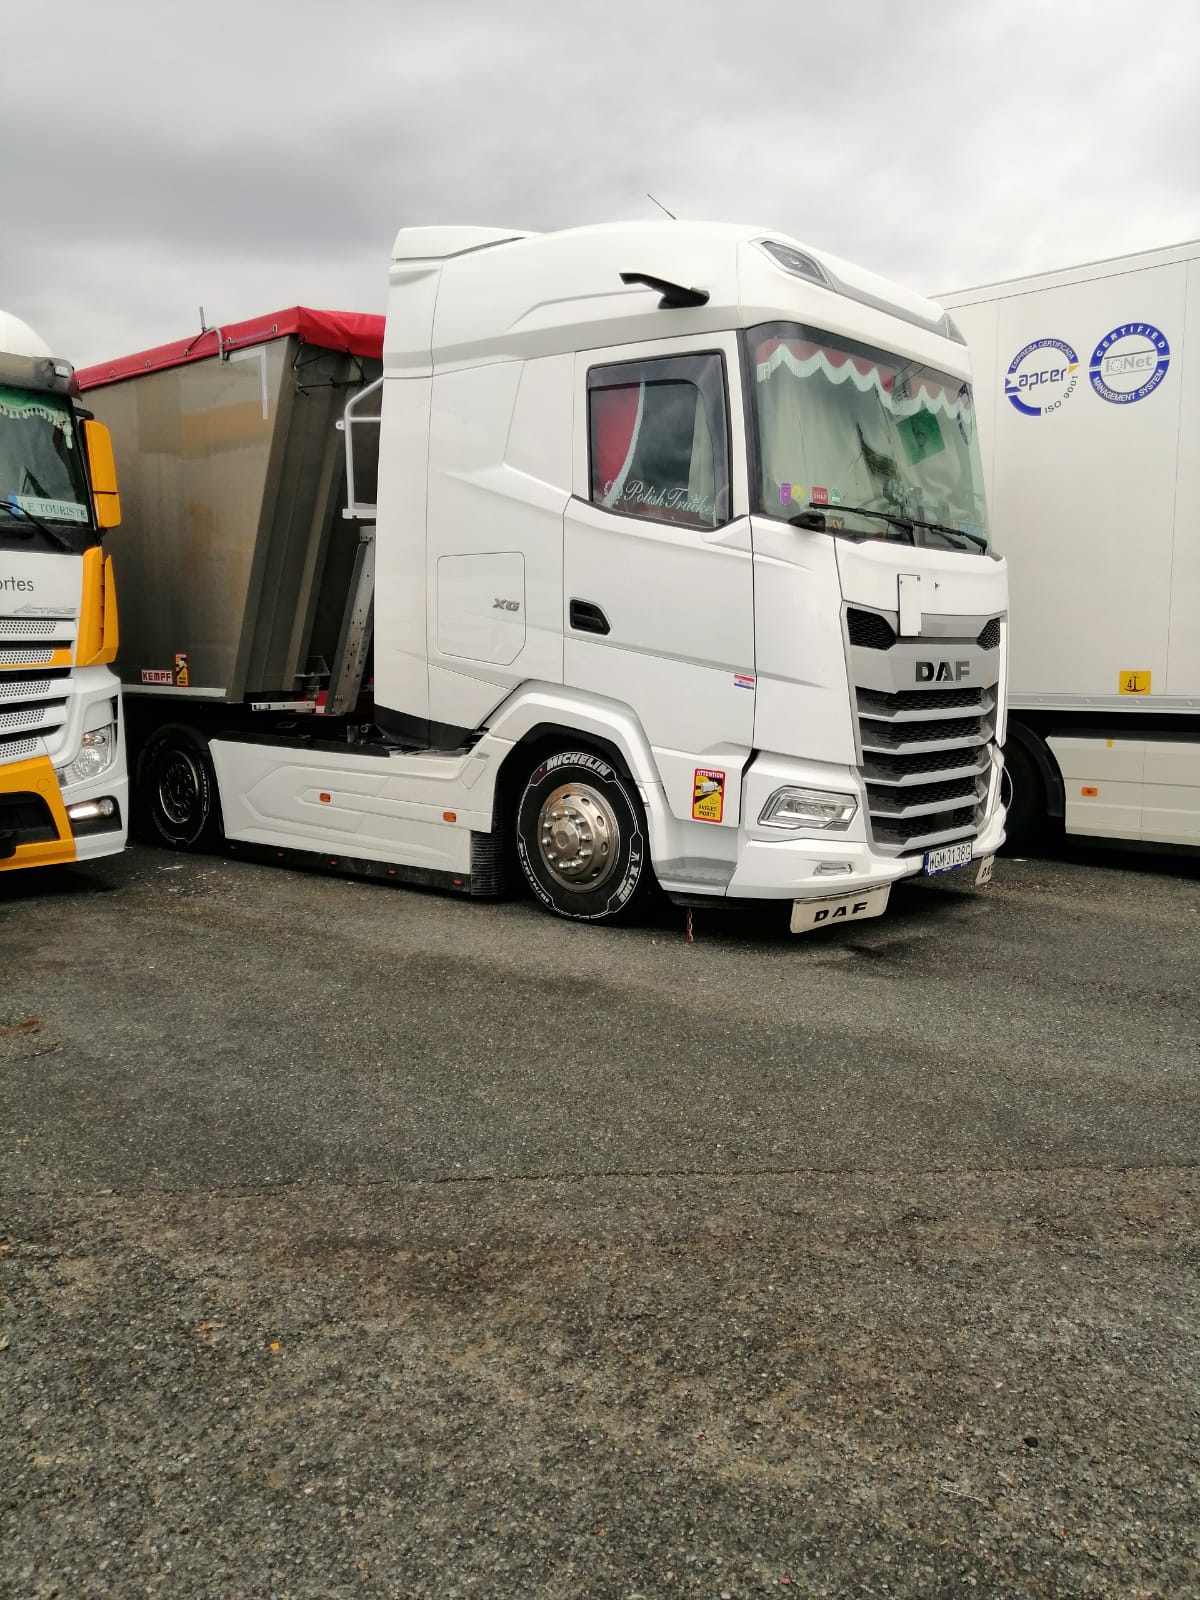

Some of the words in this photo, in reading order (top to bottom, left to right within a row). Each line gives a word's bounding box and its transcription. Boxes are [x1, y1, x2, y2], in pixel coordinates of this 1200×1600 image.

[1096, 325, 1165, 357] CERTIFIED
[1011, 342, 1038, 369] EMPRESA
[1038, 340, 1075, 360] CERTIFICADA
[1018, 367, 1068, 391] apcer
[1093, 376, 1136, 402] MANAGEMENT
[1137, 369, 1165, 397] SYSTEM
[1045, 400, 1062, 415] ISO
[1063, 375, 1078, 399] 9001
[623, 480, 665, 508] Polish
[39, 503, 87, 519] TOURISTE
[0, 577, 34, 592] rtes
[142, 671, 172, 682] KEMPF
[915, 661, 970, 682] DAF
[546, 753, 611, 777] MICHELIN
[697, 770, 724, 779] ATTENTION
[813, 901, 868, 923] DAF
